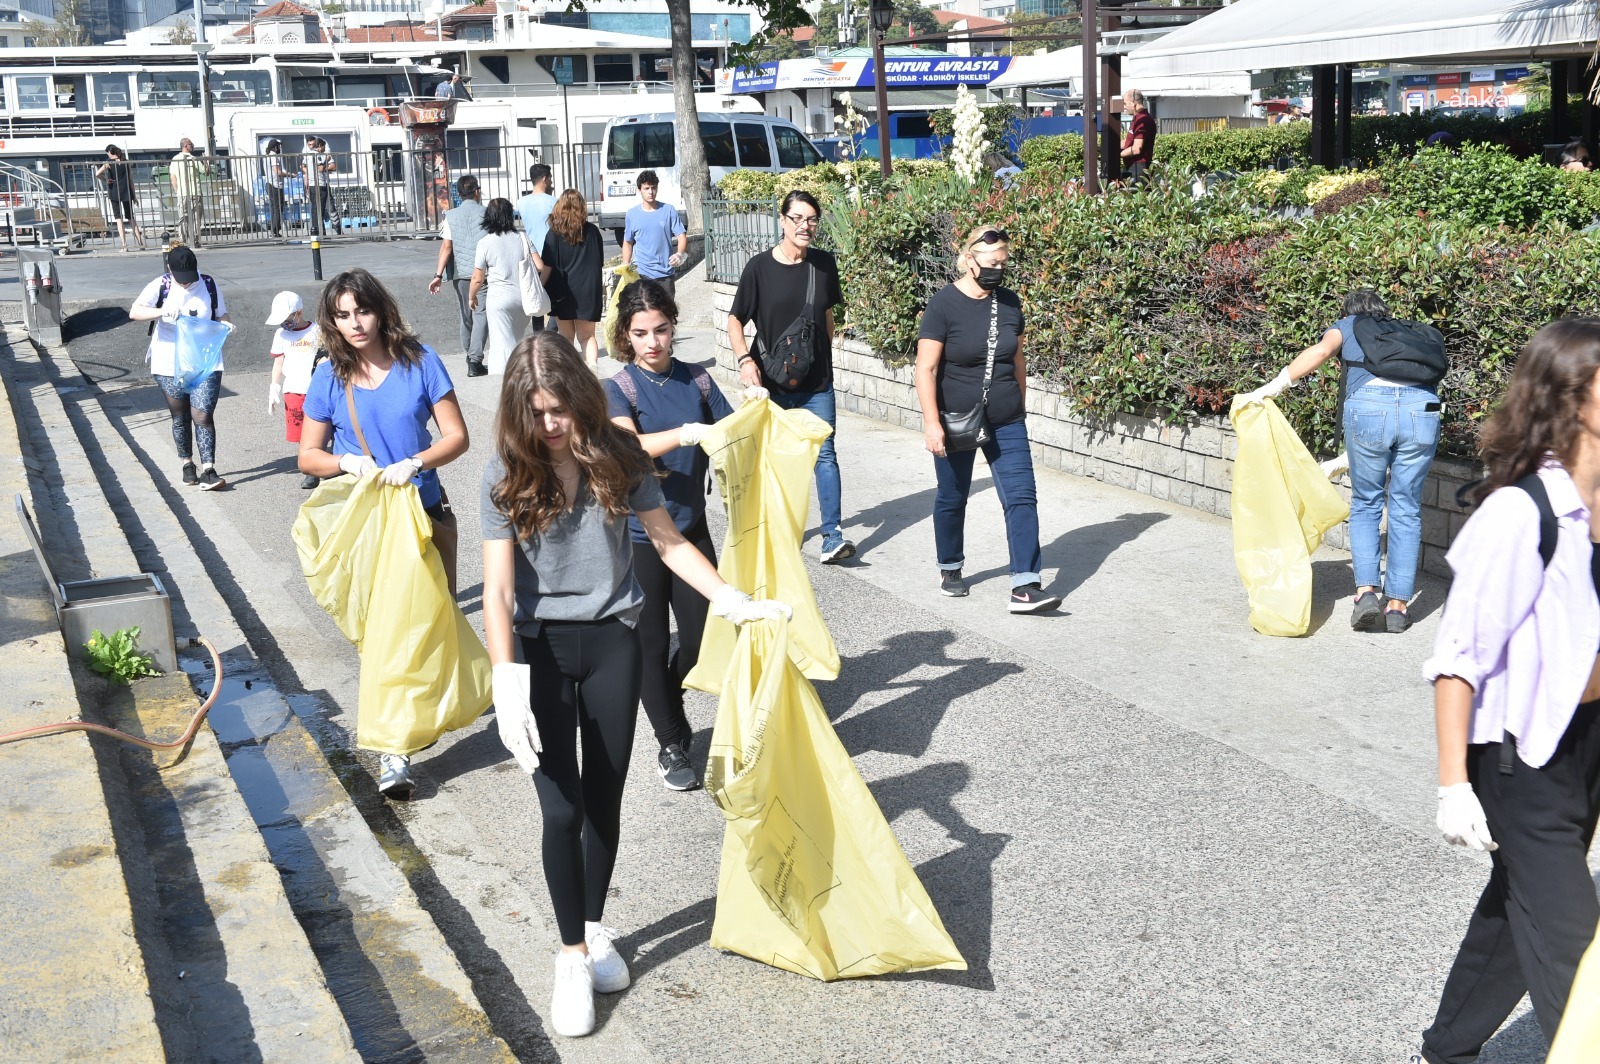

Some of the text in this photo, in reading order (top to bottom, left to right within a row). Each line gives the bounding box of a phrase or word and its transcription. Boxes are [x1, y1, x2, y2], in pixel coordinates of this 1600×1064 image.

[934, 60, 999, 71] AVRASYA
[886, 74, 917, 82] SKÜDAR
[958, 72, 990, 81] İSKELESİ
[1449, 88, 1510, 108] anka
